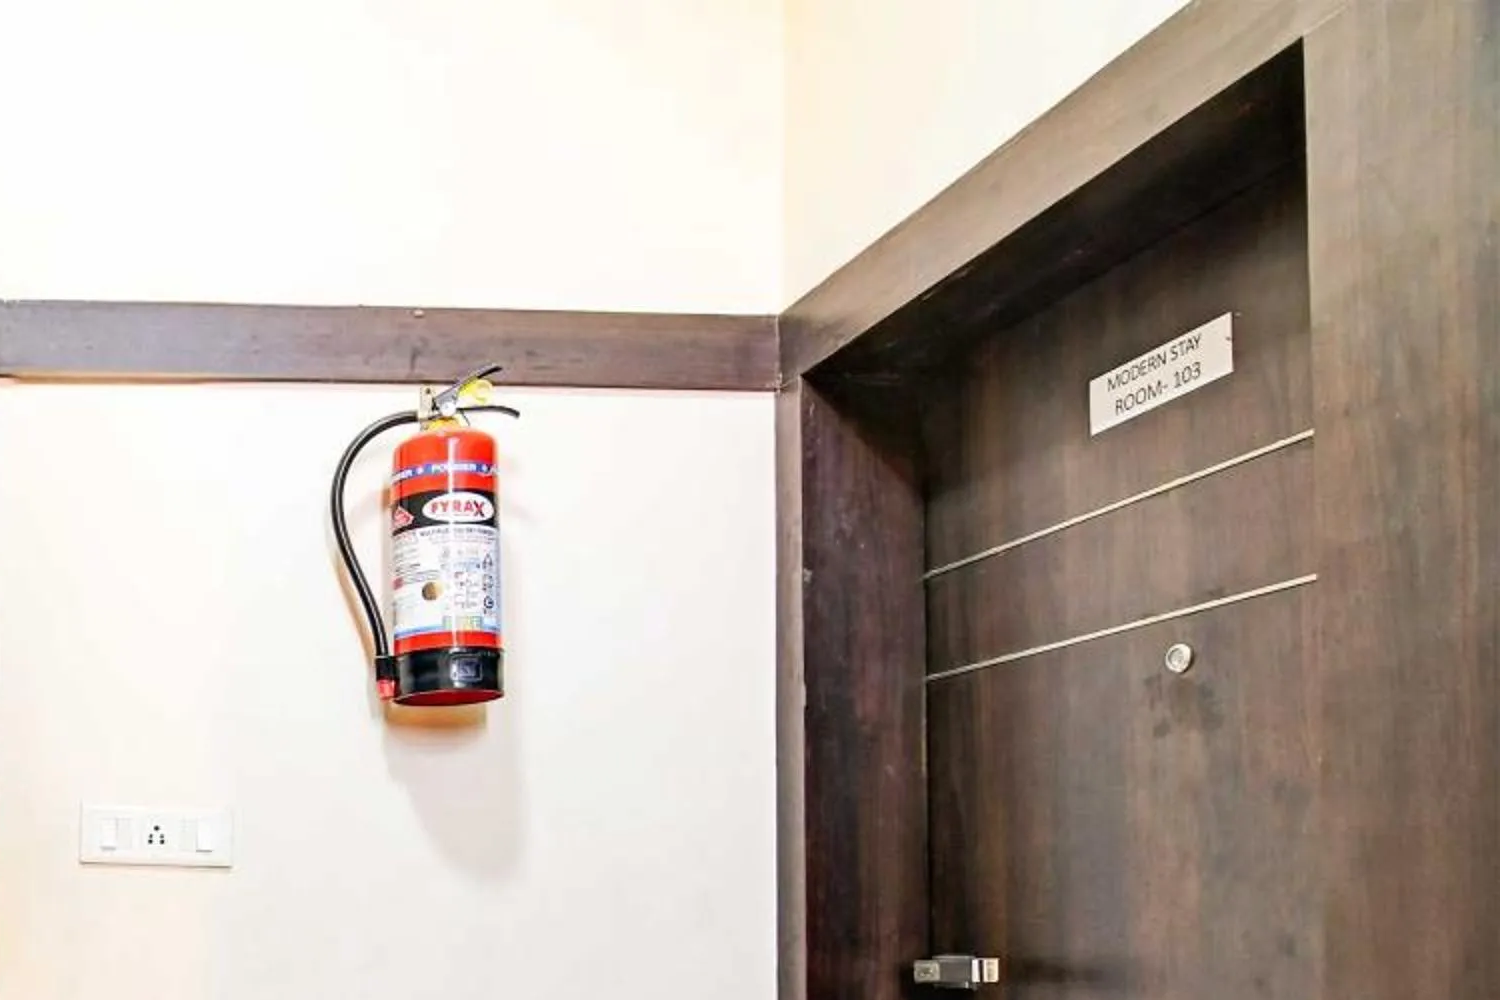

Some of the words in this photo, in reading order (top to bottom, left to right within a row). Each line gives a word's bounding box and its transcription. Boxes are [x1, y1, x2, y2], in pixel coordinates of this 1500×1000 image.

[1106, 349, 1167, 393] MODERN
[1170, 333, 1202, 362] STAY
[1114, 379, 1169, 416] ROOM-
[1173, 361, 1202, 389] 103
[430, 499, 486, 518] FYRAX
